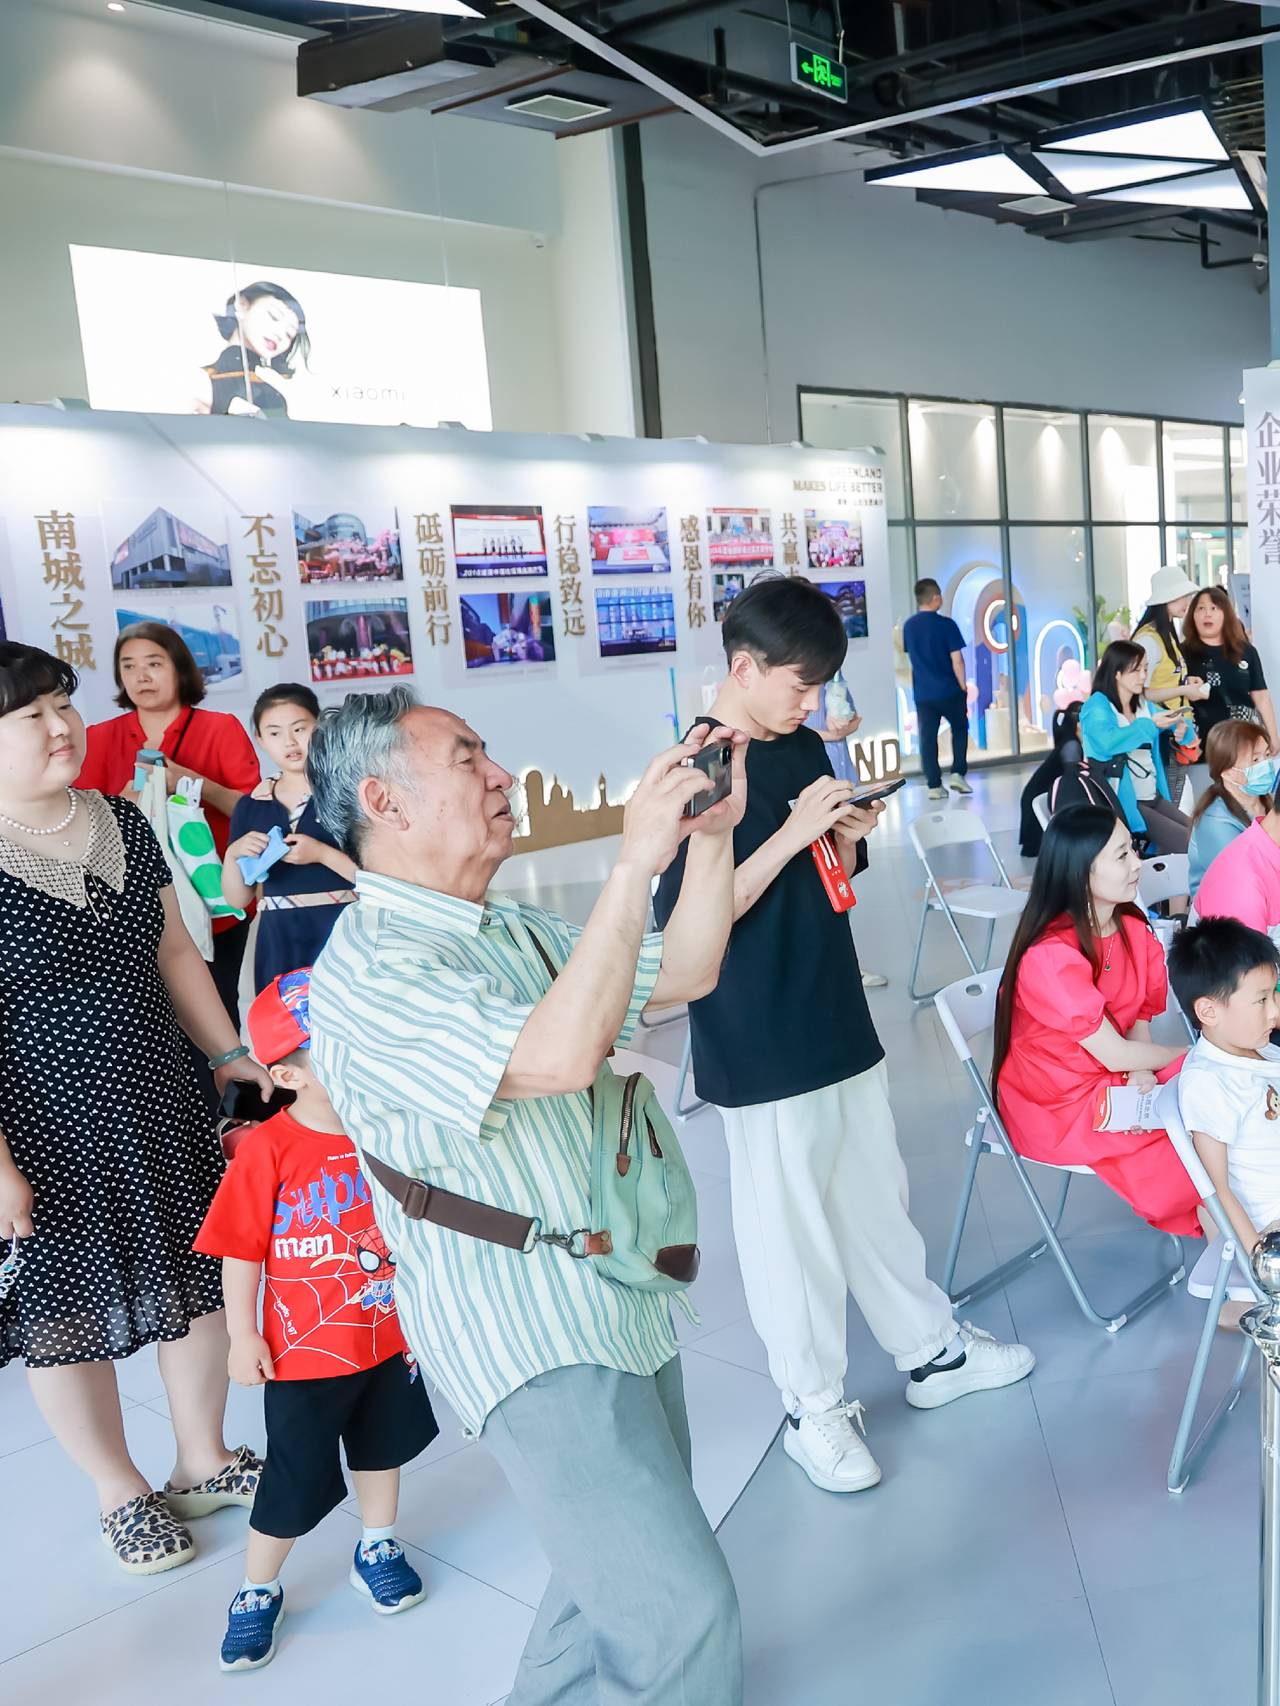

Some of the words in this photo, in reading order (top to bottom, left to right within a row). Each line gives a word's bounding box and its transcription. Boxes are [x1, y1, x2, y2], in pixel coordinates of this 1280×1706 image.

[331, 386, 405, 401] xiaomi
[34, 510, 97, 671] 南城之城
[241, 513, 288, 657] 不忘初心
[413, 513, 452, 646] 砥砺前行
[554, 514, 586, 637] 行稳致远
[680, 514, 707, 629] 感恩有你
[275, 1233, 334, 1259] man
